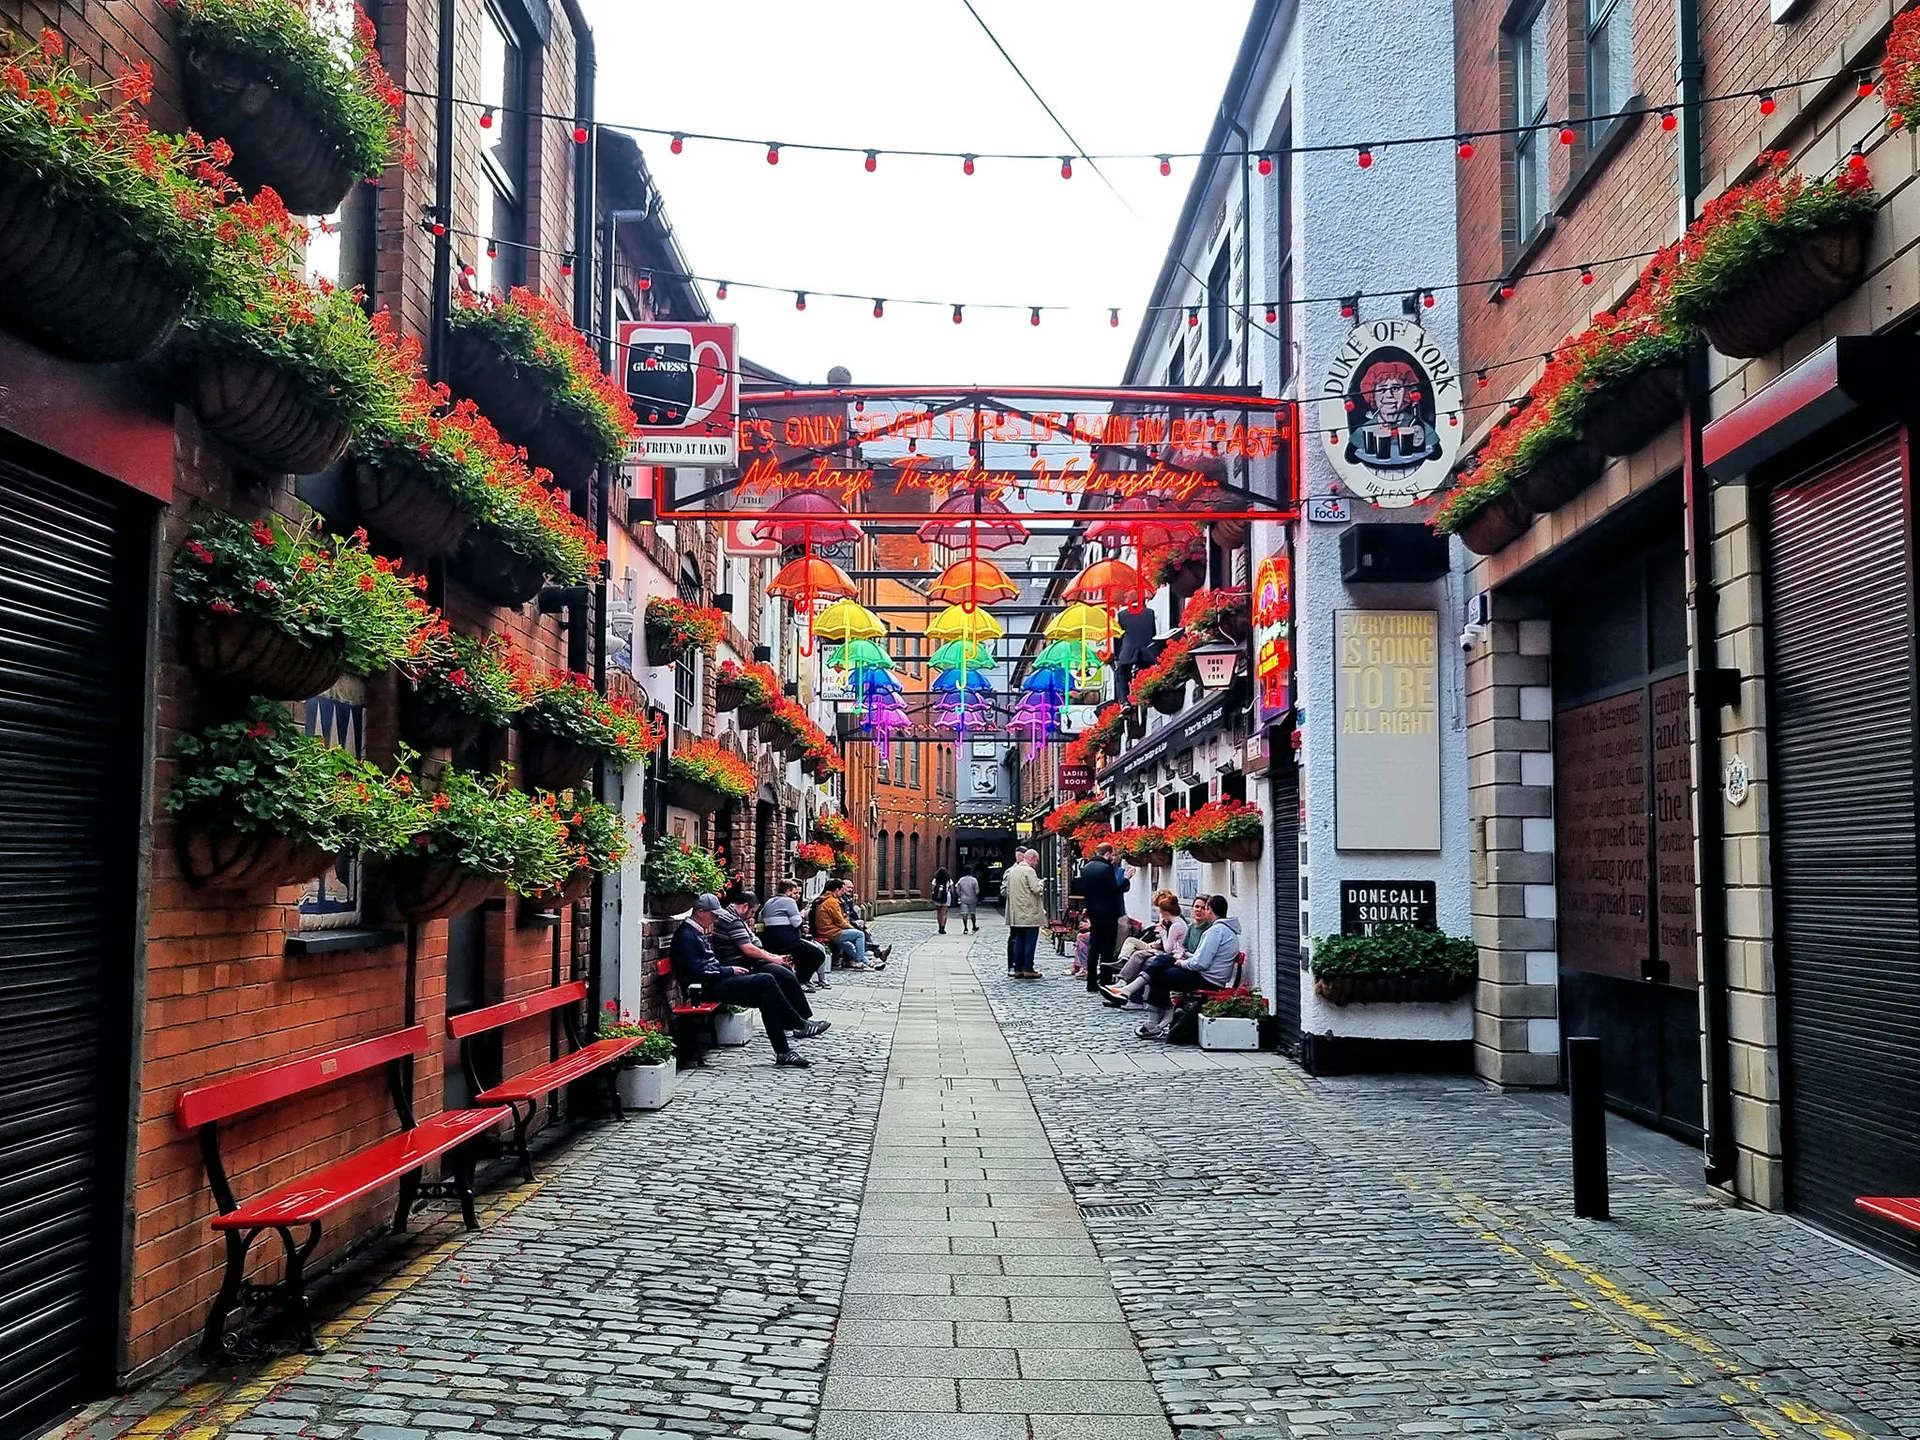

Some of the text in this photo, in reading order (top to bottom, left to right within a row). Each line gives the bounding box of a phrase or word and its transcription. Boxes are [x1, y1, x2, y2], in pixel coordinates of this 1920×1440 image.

[1323, 321, 1457, 396] DUKE OF YORK
[786, 414, 843, 448] ONLY
[855, 411, 935, 442] SEVEN
[944, 411, 1021, 442] TYPES
[1030, 412, 1062, 441] OF
[1071, 412, 1132, 445] RAIN
[646, 442, 682, 454] FRIEND
[684, 443, 697, 455] AT
[699, 444, 727, 456] HAND
[1365, 481, 1420, 499] BELFAST
[1314, 507, 1346, 520] focus
[1340, 614, 1434, 635] EVERYTHING
[1341, 636, 1434, 665] IS GOING
[1340, 665, 1434, 709] TO BE
[1342, 711, 1433, 734] ALL RIGHT
[1656, 716, 1680, 751] and
[1657, 788, 1682, 822] the
[1348, 889, 1429, 904] DONECALL
[1359, 906, 1419, 921] SQUARE
